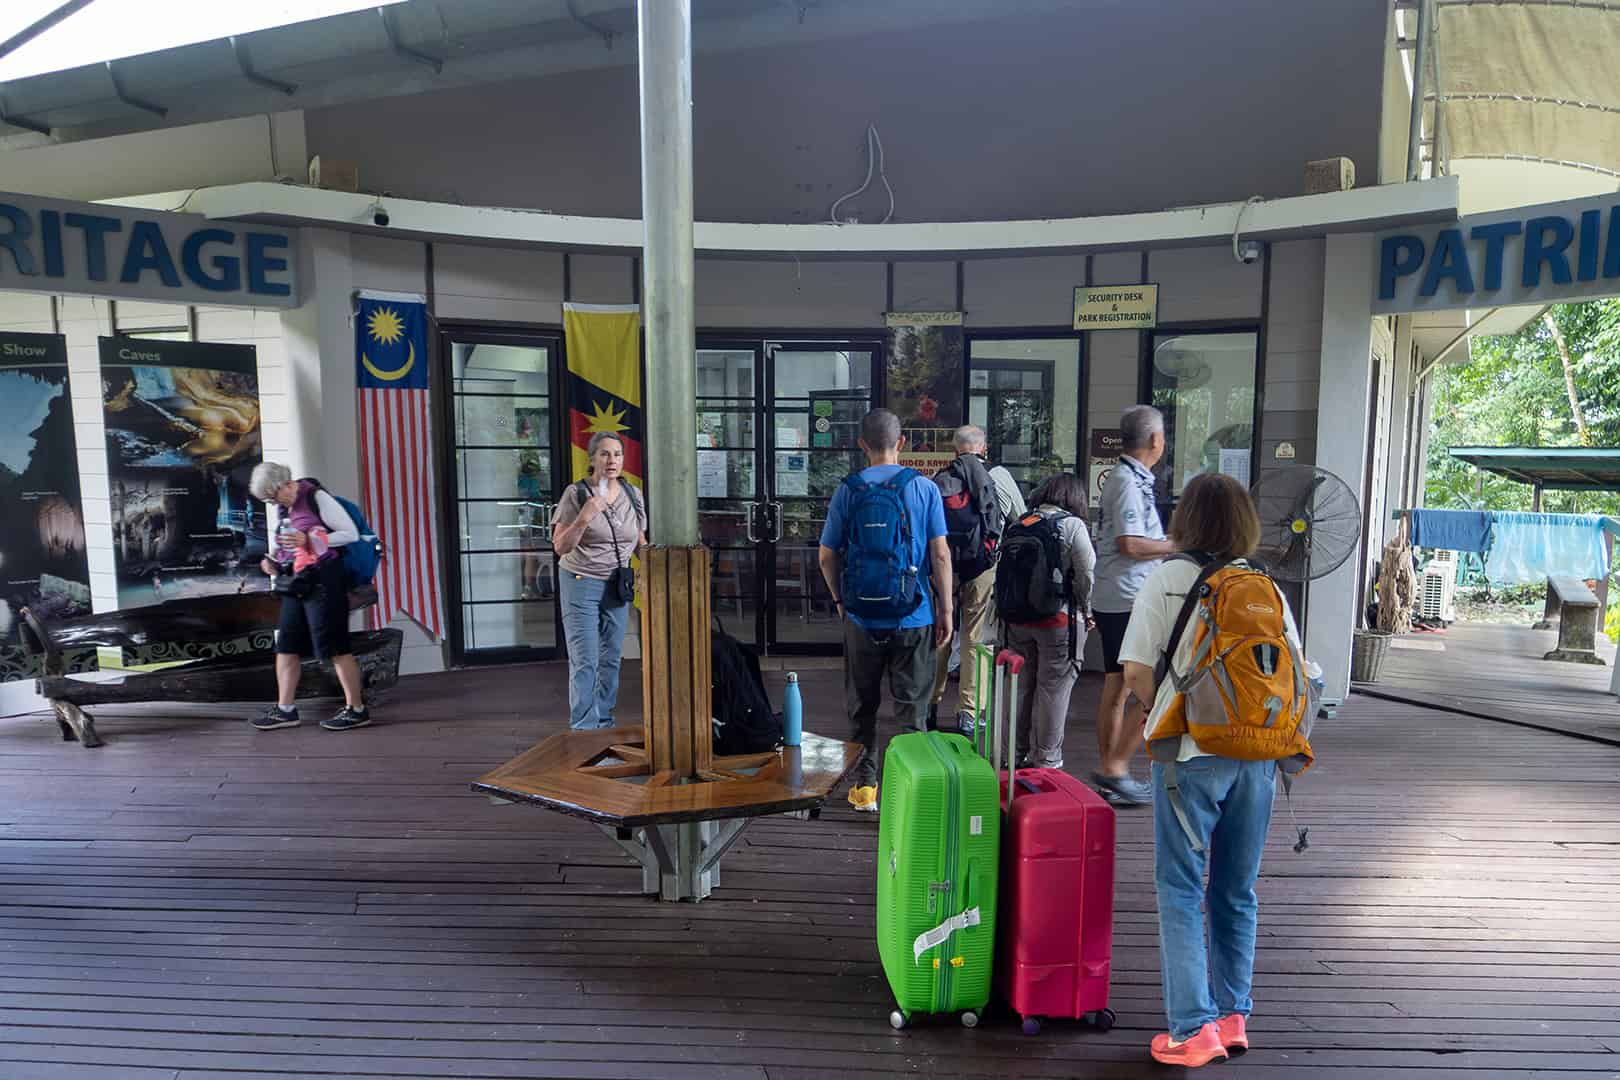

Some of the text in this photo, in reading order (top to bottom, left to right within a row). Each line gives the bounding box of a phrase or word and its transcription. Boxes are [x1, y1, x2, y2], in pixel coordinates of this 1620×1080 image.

[1087, 292, 1143, 303] SECURITY DESK
[1078, 312, 1152, 323] PARK REGISTRATION
[3, 343, 46, 357] Show
[119, 348, 161, 362] Caves
